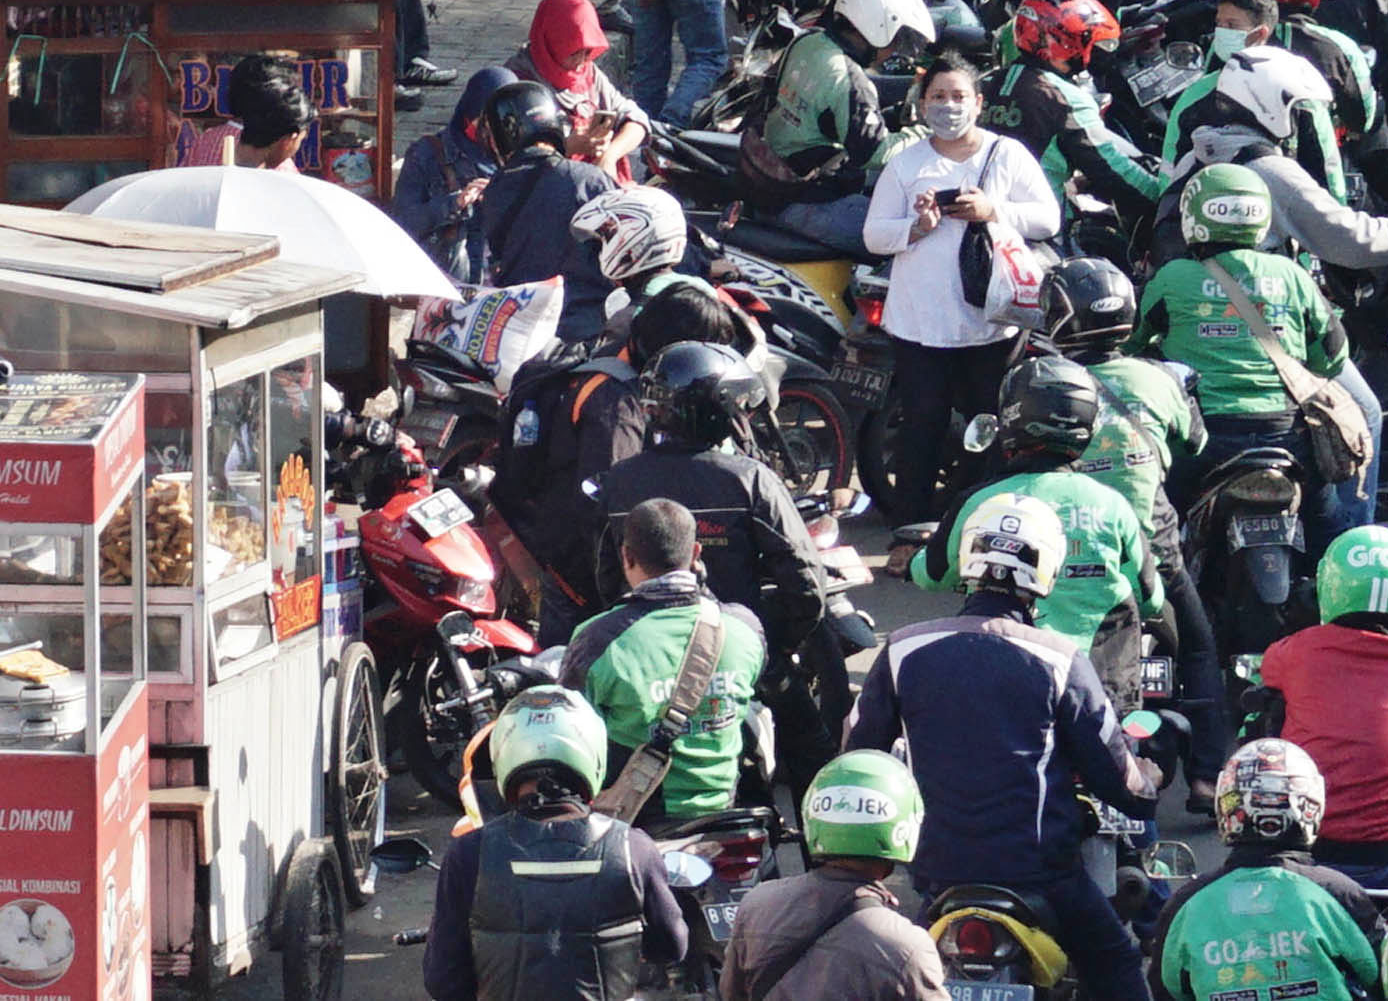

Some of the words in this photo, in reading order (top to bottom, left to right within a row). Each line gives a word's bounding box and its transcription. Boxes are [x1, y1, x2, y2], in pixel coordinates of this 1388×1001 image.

[1208, 202, 1228, 217] GO
[811, 797, 833, 815] GO
[847, 797, 889, 817] JEK
[9, 808, 74, 832] DIMSUM
[21, 879, 81, 894] KOMBINASI
[711, 908, 722, 924] B
[1203, 940, 1239, 966] GO
[1267, 929, 1312, 957] JEK
